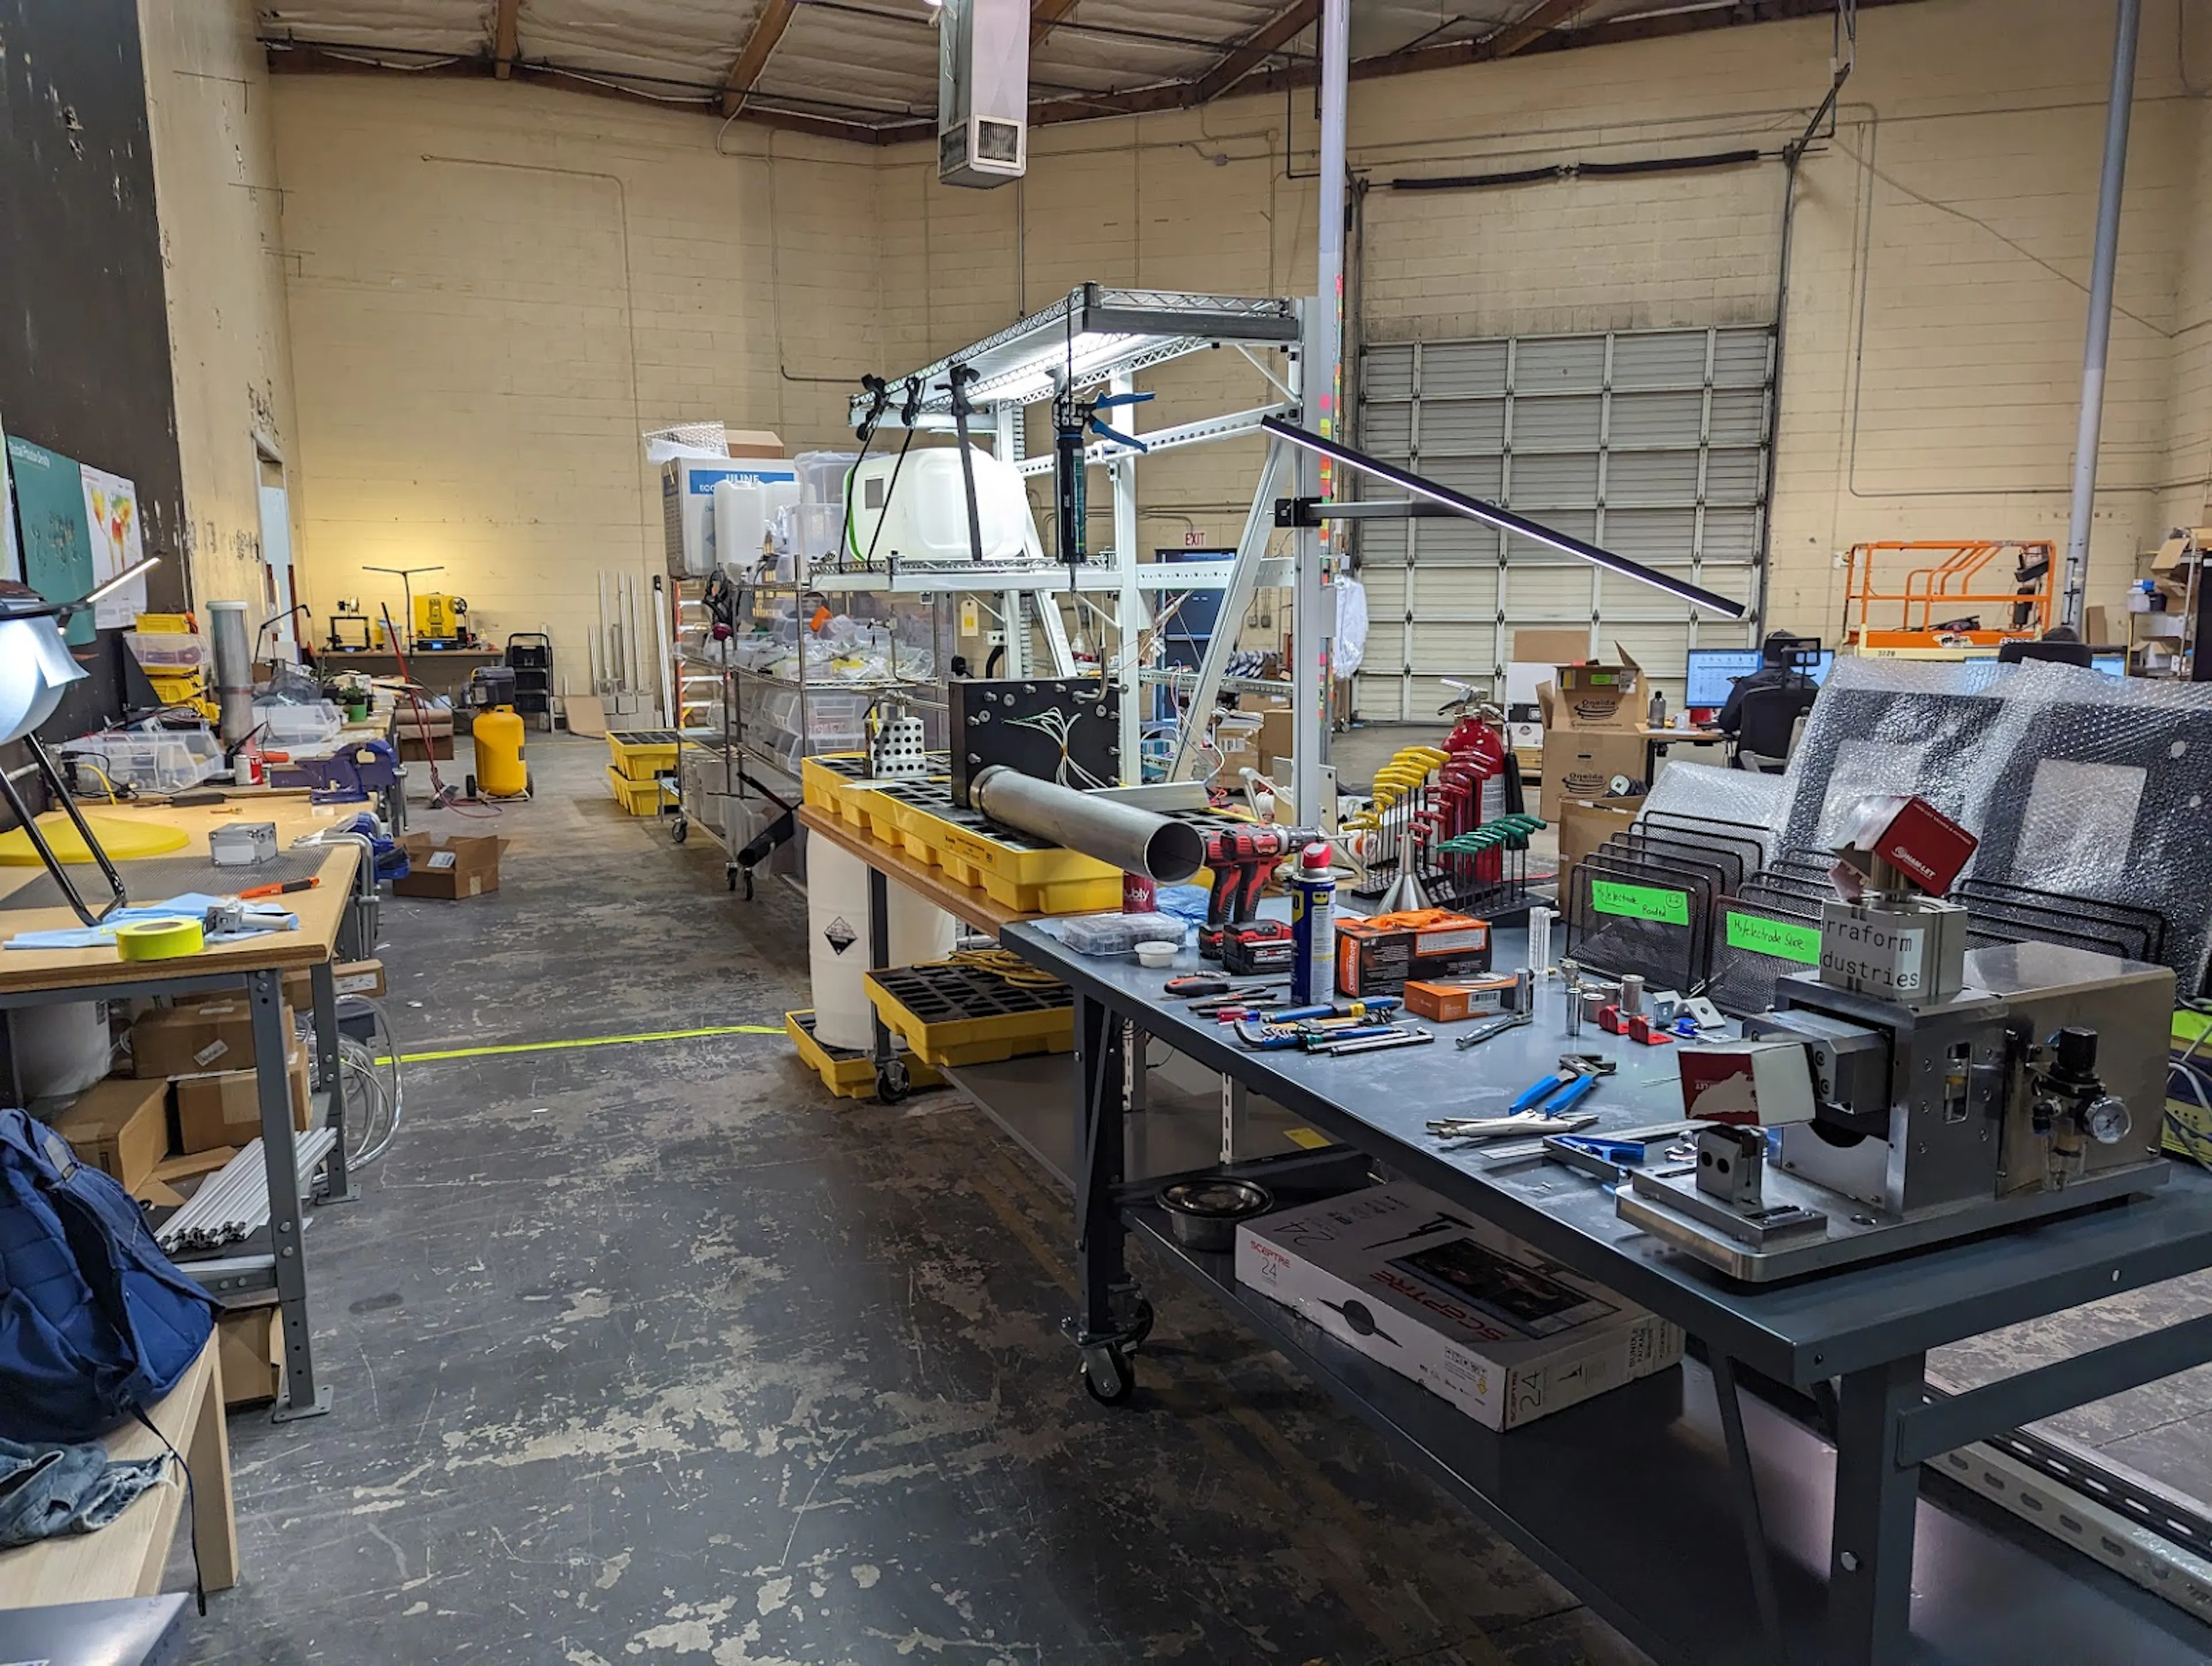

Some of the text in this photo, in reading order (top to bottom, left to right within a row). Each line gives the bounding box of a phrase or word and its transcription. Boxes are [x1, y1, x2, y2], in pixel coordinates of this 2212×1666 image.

[1185, 533, 1205, 546] EXIT
[1827, 921, 1912, 951] rraform
[1823, 951, 1918, 987] dustries
[1250, 1240, 1290, 1269] SCEPTRE
[1262, 1256, 1277, 1279] 24
[1369, 1270, 1508, 1341] SCEPTRE
[1510, 1370, 1518, 1422] SCEPTRE
[1521, 1370, 1541, 1412] 24
